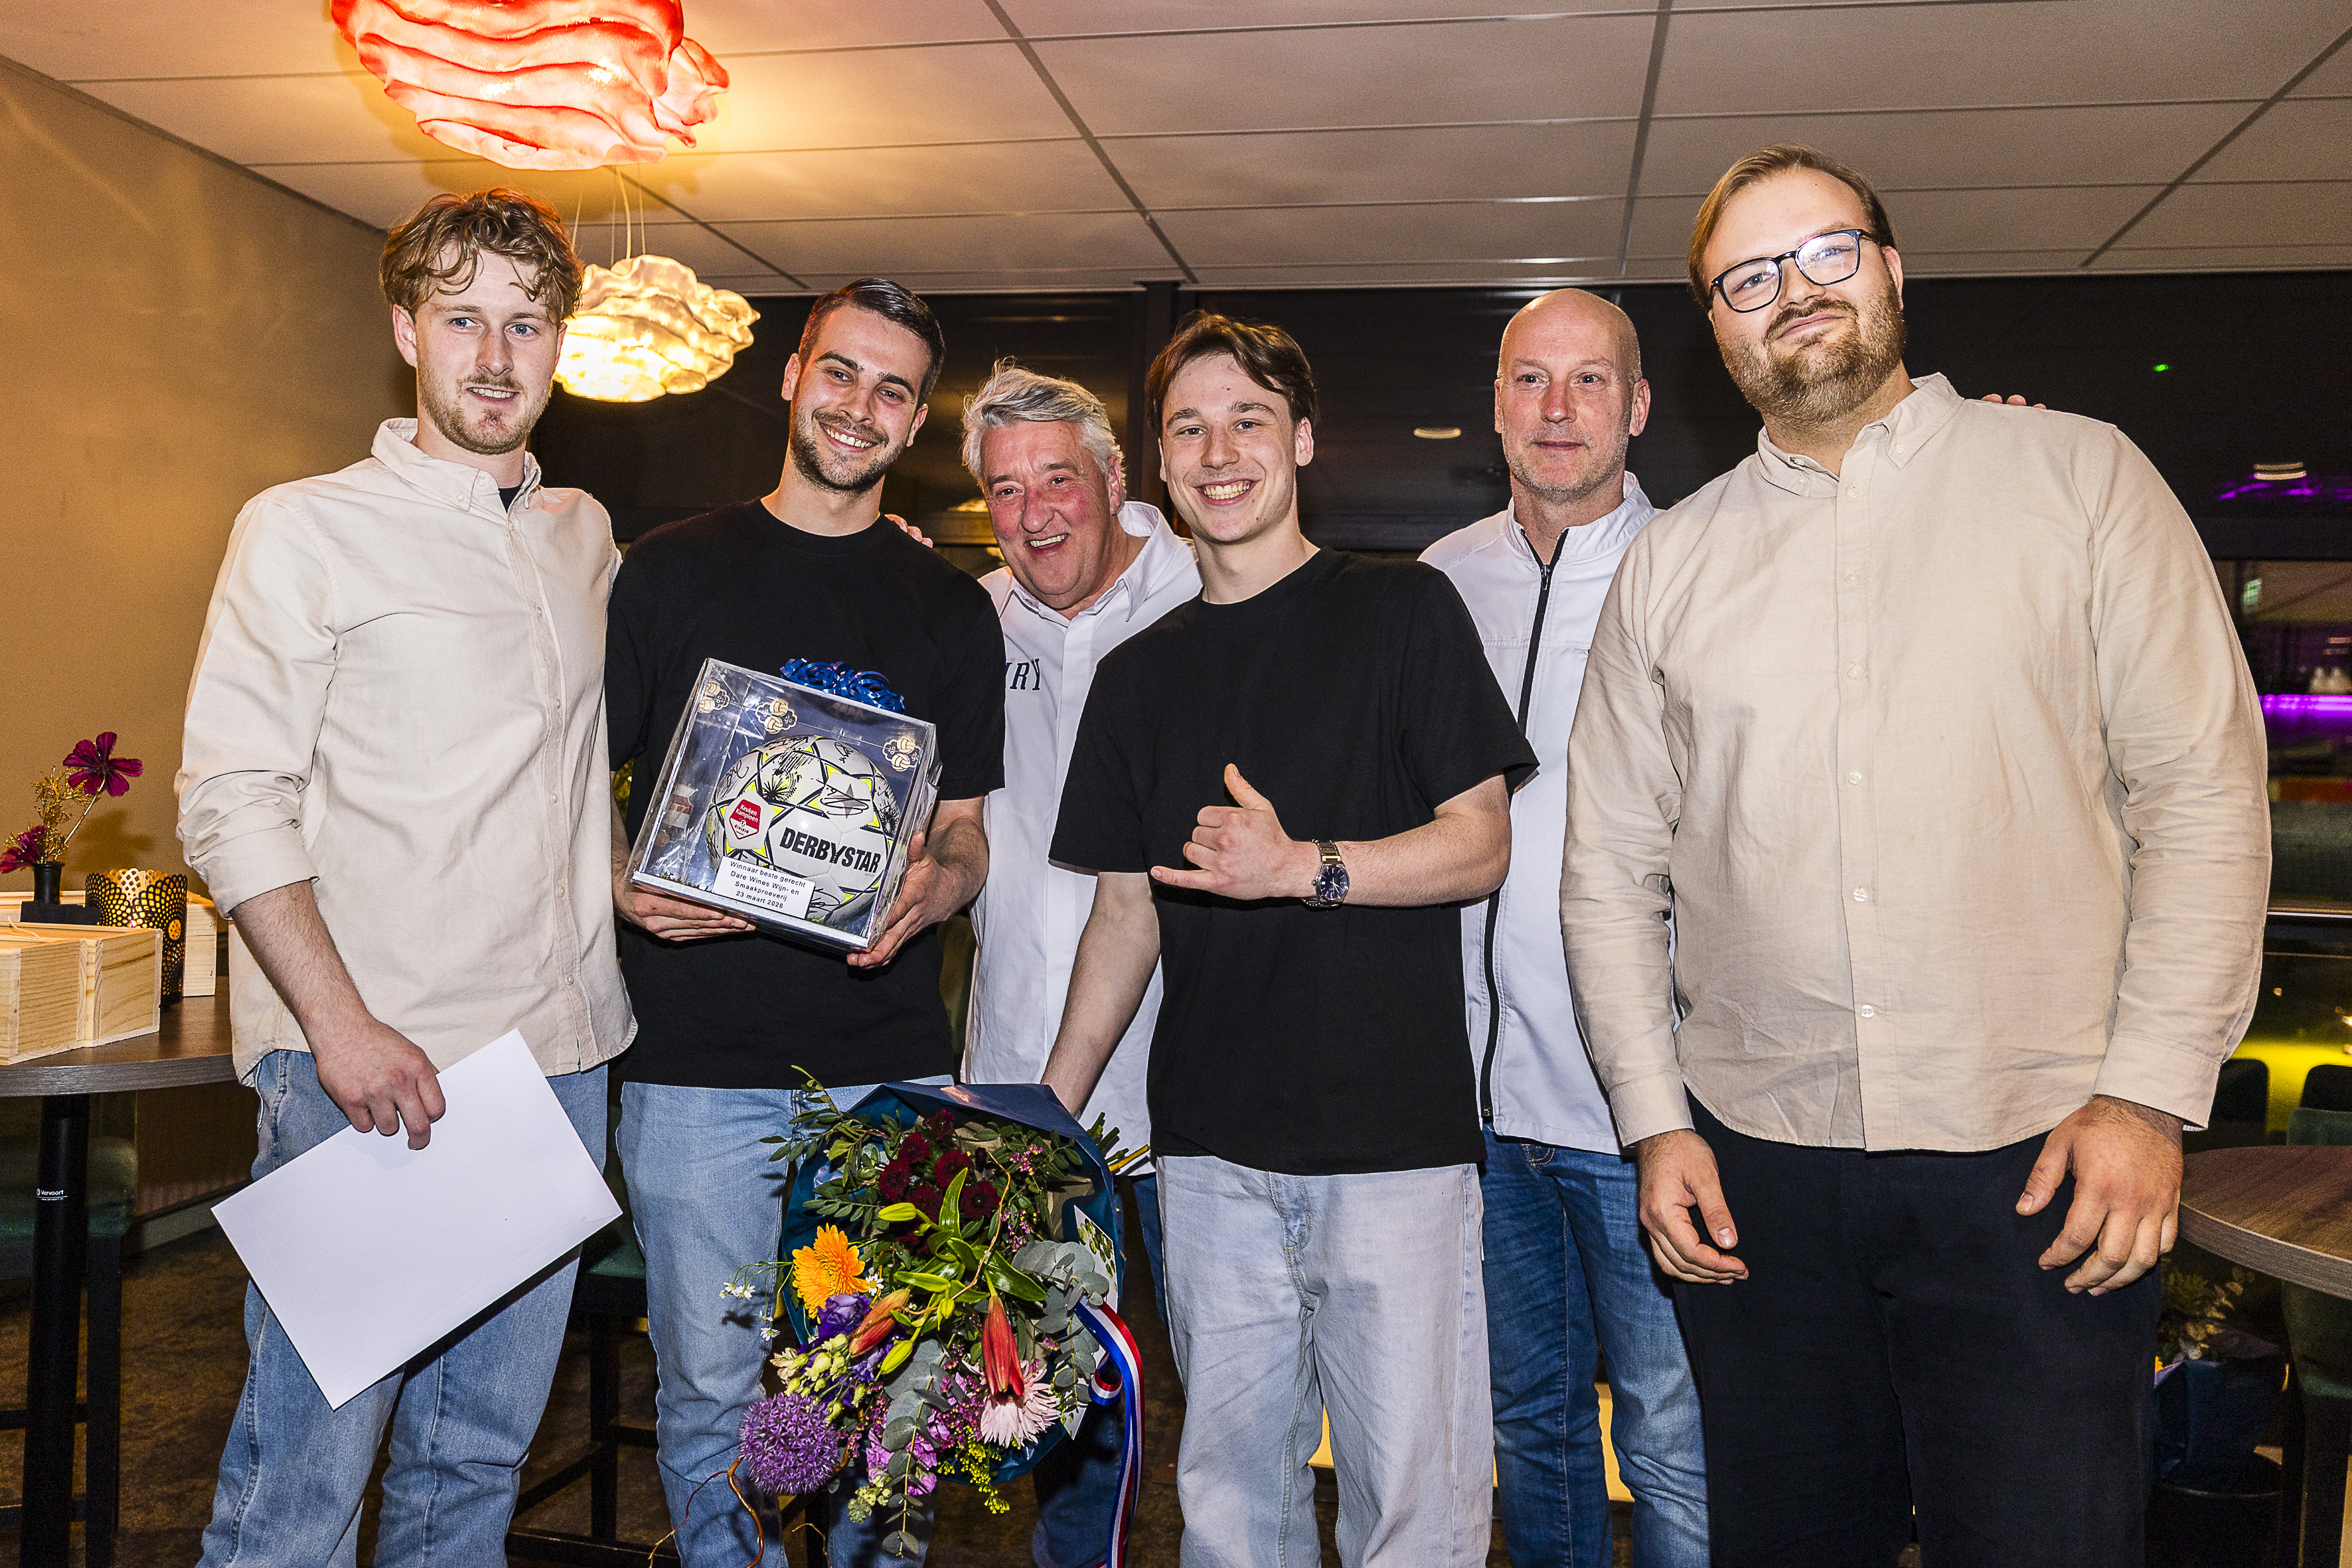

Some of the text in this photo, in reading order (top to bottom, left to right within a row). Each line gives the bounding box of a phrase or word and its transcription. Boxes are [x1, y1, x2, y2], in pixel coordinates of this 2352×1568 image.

[736, 808, 759, 823] Kampioen
[740, 804, 757, 817] Keuken
[779, 826, 882, 874] DERBYSTAR
[730, 860, 806, 888] Winnaar beste gerecht
[730, 870, 747, 880] Dare
[749, 876, 769, 887] Wines
[772, 882, 789, 892] Wijn-
[735, 881, 787, 902] Smaakproeverij
[746, 894, 765, 903] maart
[767, 900, 784, 909] 2026
